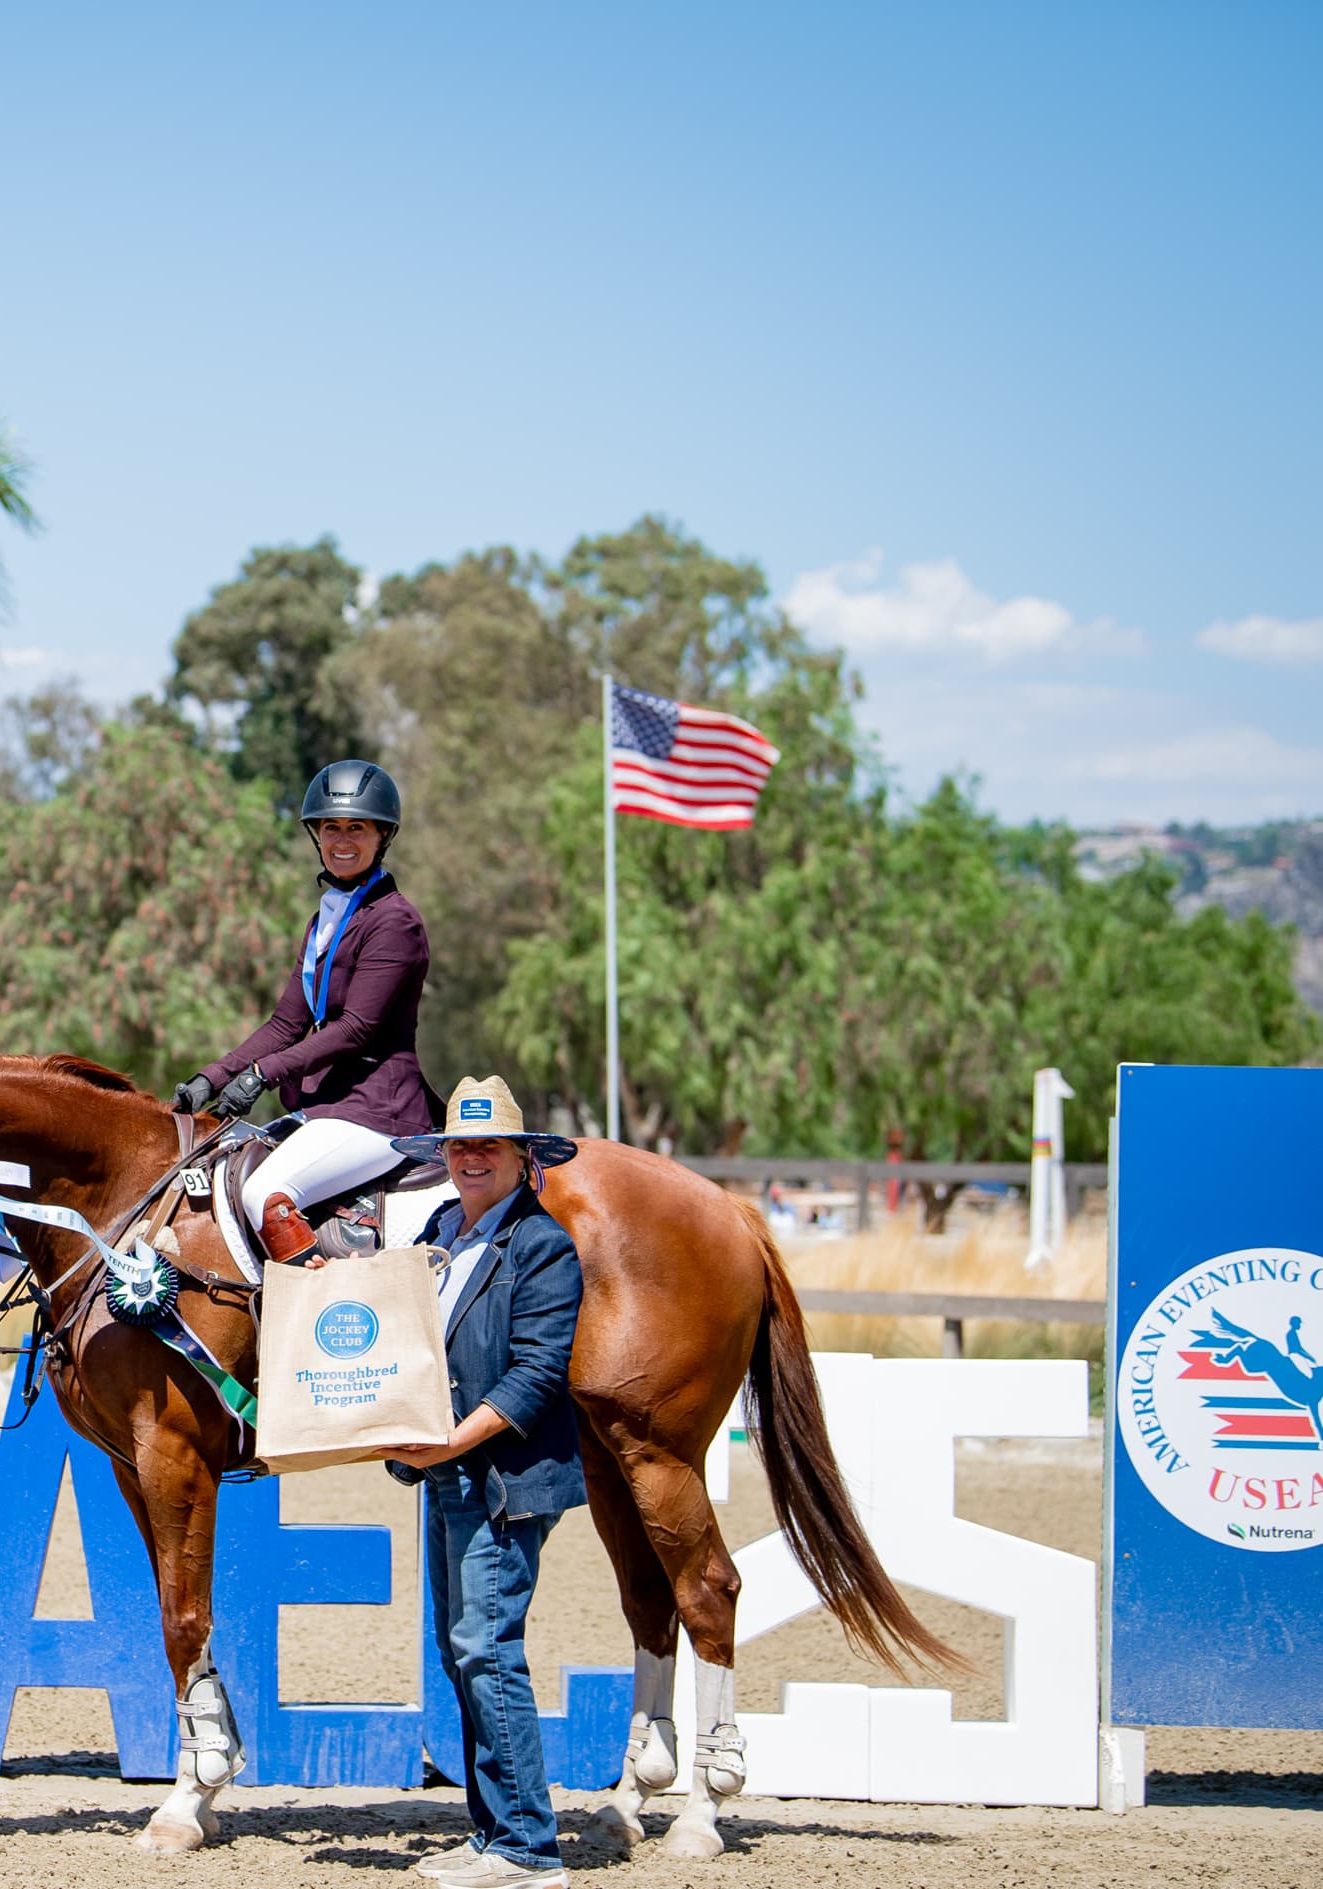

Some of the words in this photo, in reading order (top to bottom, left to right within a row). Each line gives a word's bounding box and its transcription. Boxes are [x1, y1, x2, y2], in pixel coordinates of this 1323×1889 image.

[184, 1173, 209, 1191] 91
[108, 1254, 140, 1276] TENTH
[1157, 1258, 1302, 1326] EVENTING
[335, 1313, 360, 1323] THE
[321, 1325, 370, 1335] JOCKEY
[330, 1337, 363, 1347] CLUB
[295, 1362, 398, 1383] Thoroughbred
[310, 1380, 381, 1393] Incentive
[313, 1393, 377, 1408] Program
[1131, 1325, 1190, 1474] AMERICAN
[1208, 1466, 1323, 1511] USEA
[1249, 1524, 1314, 1539] Nutrena
